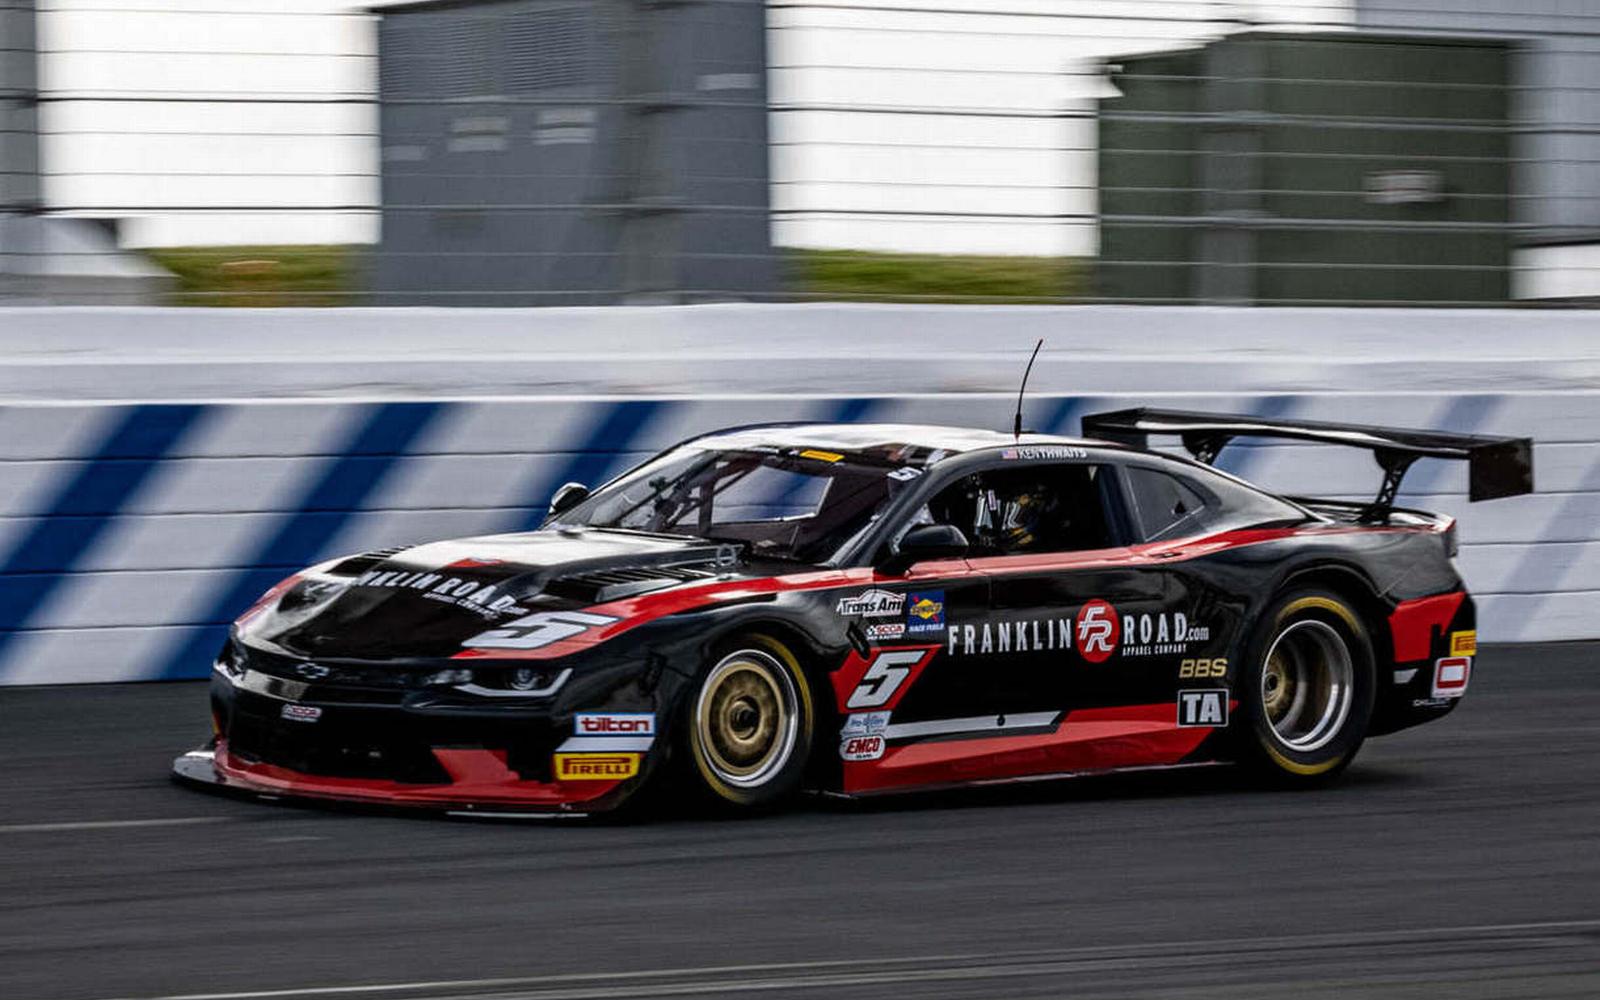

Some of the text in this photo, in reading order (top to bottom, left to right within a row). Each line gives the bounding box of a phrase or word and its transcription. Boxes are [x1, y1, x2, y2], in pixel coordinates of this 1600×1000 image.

[841, 597, 901, 613] Trans Am
[460, 611, 622, 649] 5
[948, 618, 1071, 656] FRANKLIN
[1154, 643, 1187, 655] COMPANY
[1178, 658, 1228, 679] BBS
[846, 650, 927, 709] 5
[1182, 693, 1223, 723] TA
[581, 717, 650, 732] tilton
[846, 738, 880, 755] EMCO
[562, 757, 632, 775] PIRELLI
